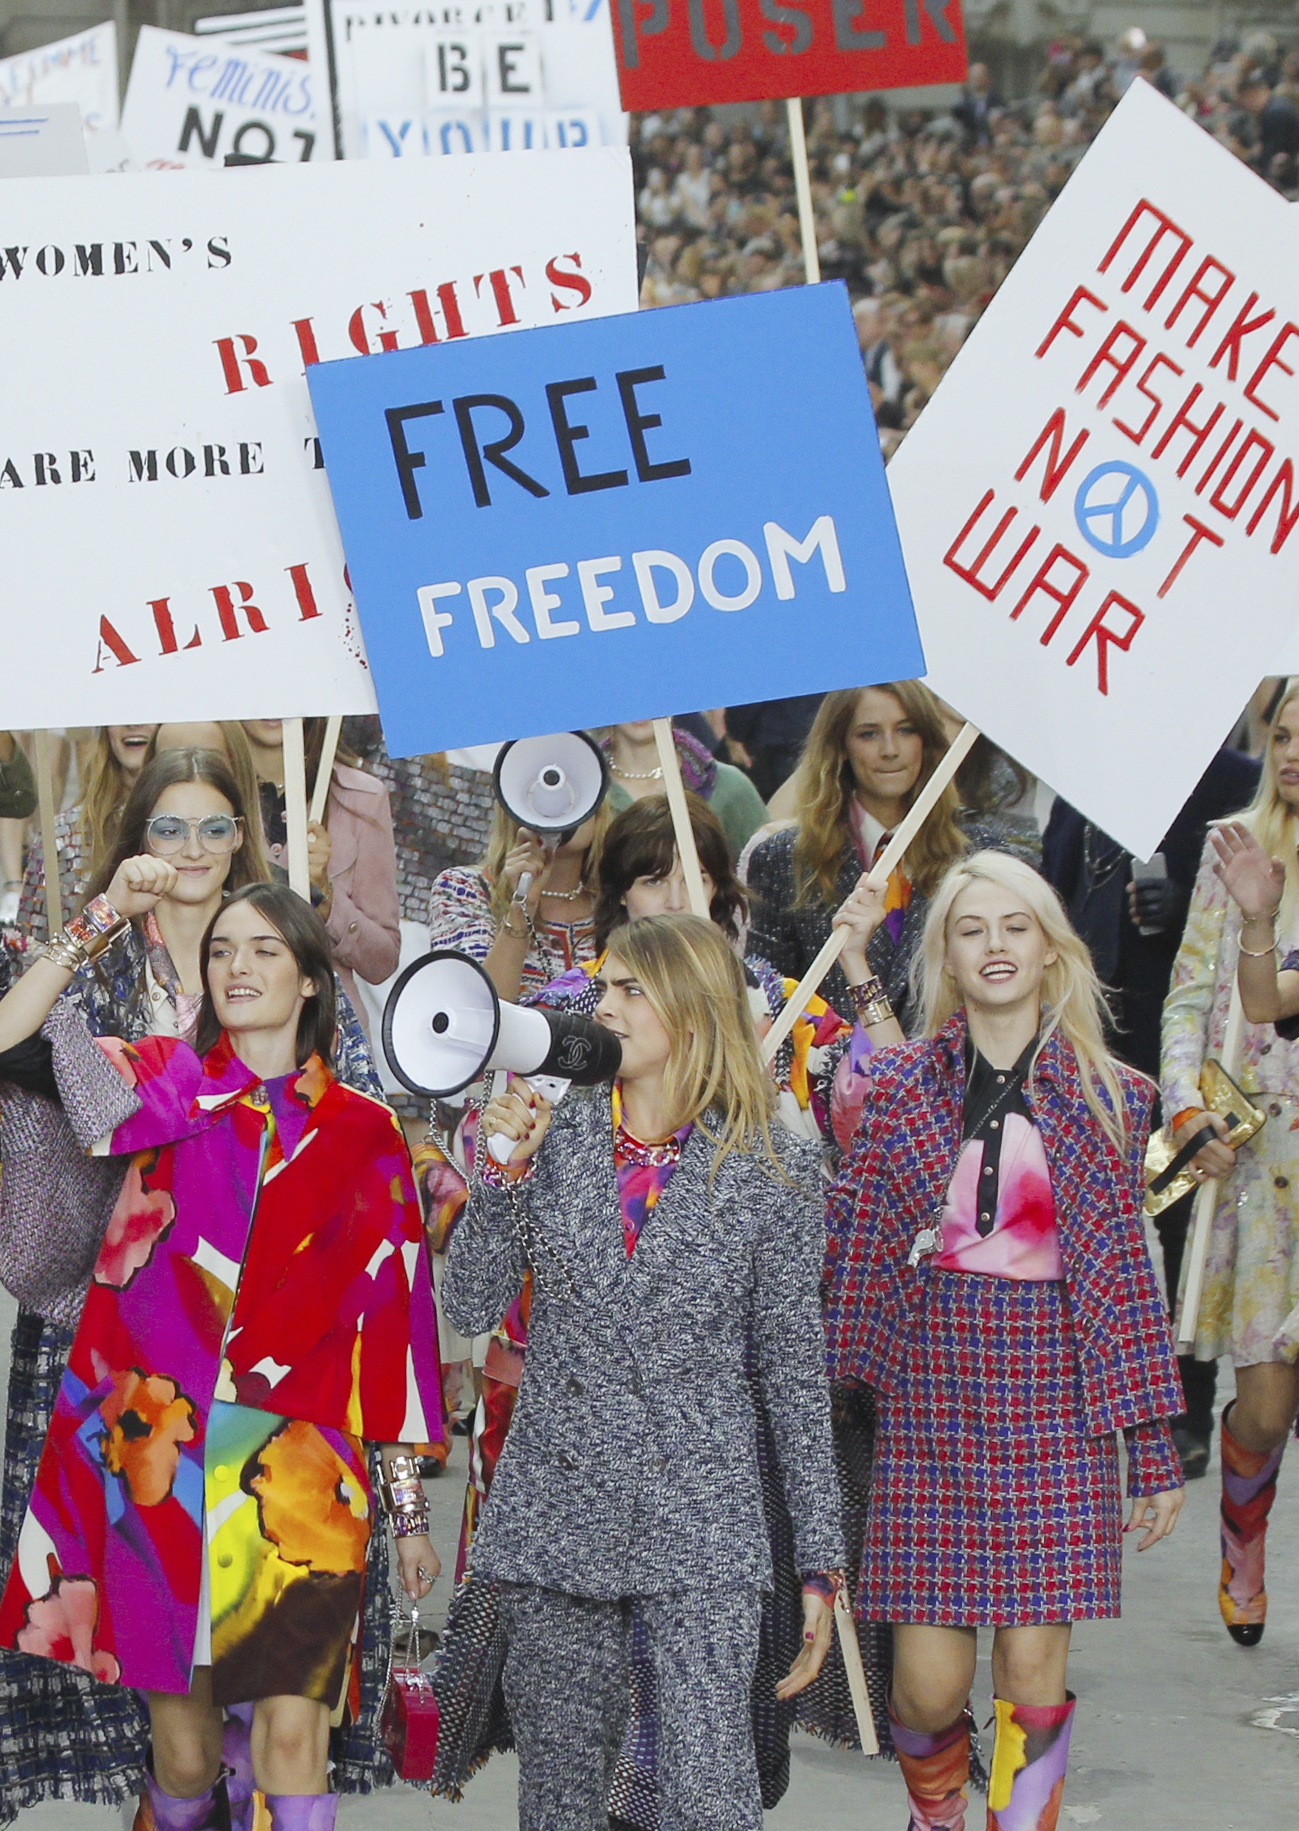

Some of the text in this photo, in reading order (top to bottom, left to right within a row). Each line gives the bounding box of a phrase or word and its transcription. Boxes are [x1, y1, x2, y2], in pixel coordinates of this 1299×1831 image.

[436, 42, 532, 94] BE
[211, 251, 593, 396] RIGHTS
[1097, 197, 1299, 422] MAKE
[127, 440, 266, 485] MORE
[383, 363, 693, 521] FREE
[1034, 284, 1299, 555] FASHION
[90, 561, 354, 676] ALRI
[415, 514, 847, 659] FREEDOM
[943, 488, 1146, 697] WAR
